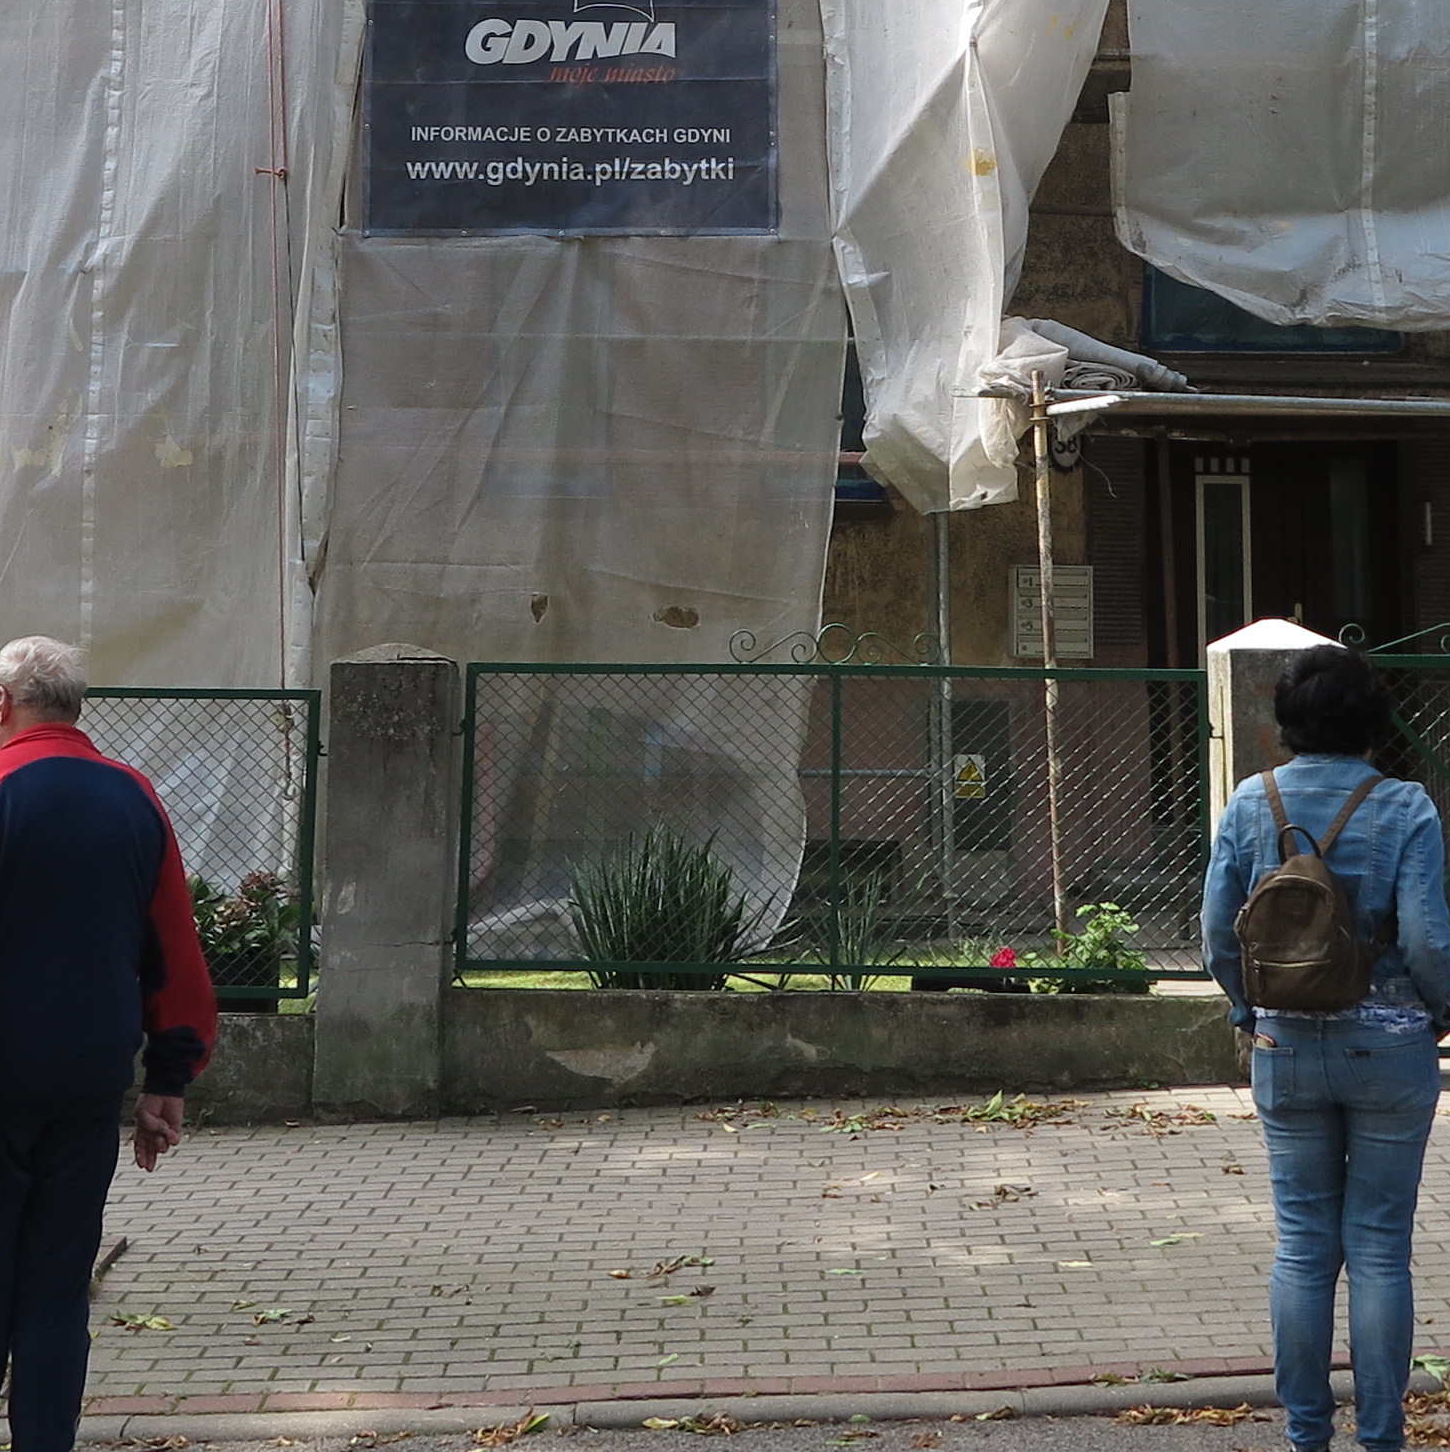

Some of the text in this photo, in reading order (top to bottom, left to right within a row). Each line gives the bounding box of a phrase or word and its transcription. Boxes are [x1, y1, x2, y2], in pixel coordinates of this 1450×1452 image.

[465, 18, 676, 65] GDYNIA
[549, 62, 676, 87] moje miasto
[411, 126, 730, 144] INFORMACJE O ZABYTKACH GDYNI
[406, 157, 734, 187] www.gdynia.pl/zabytki
